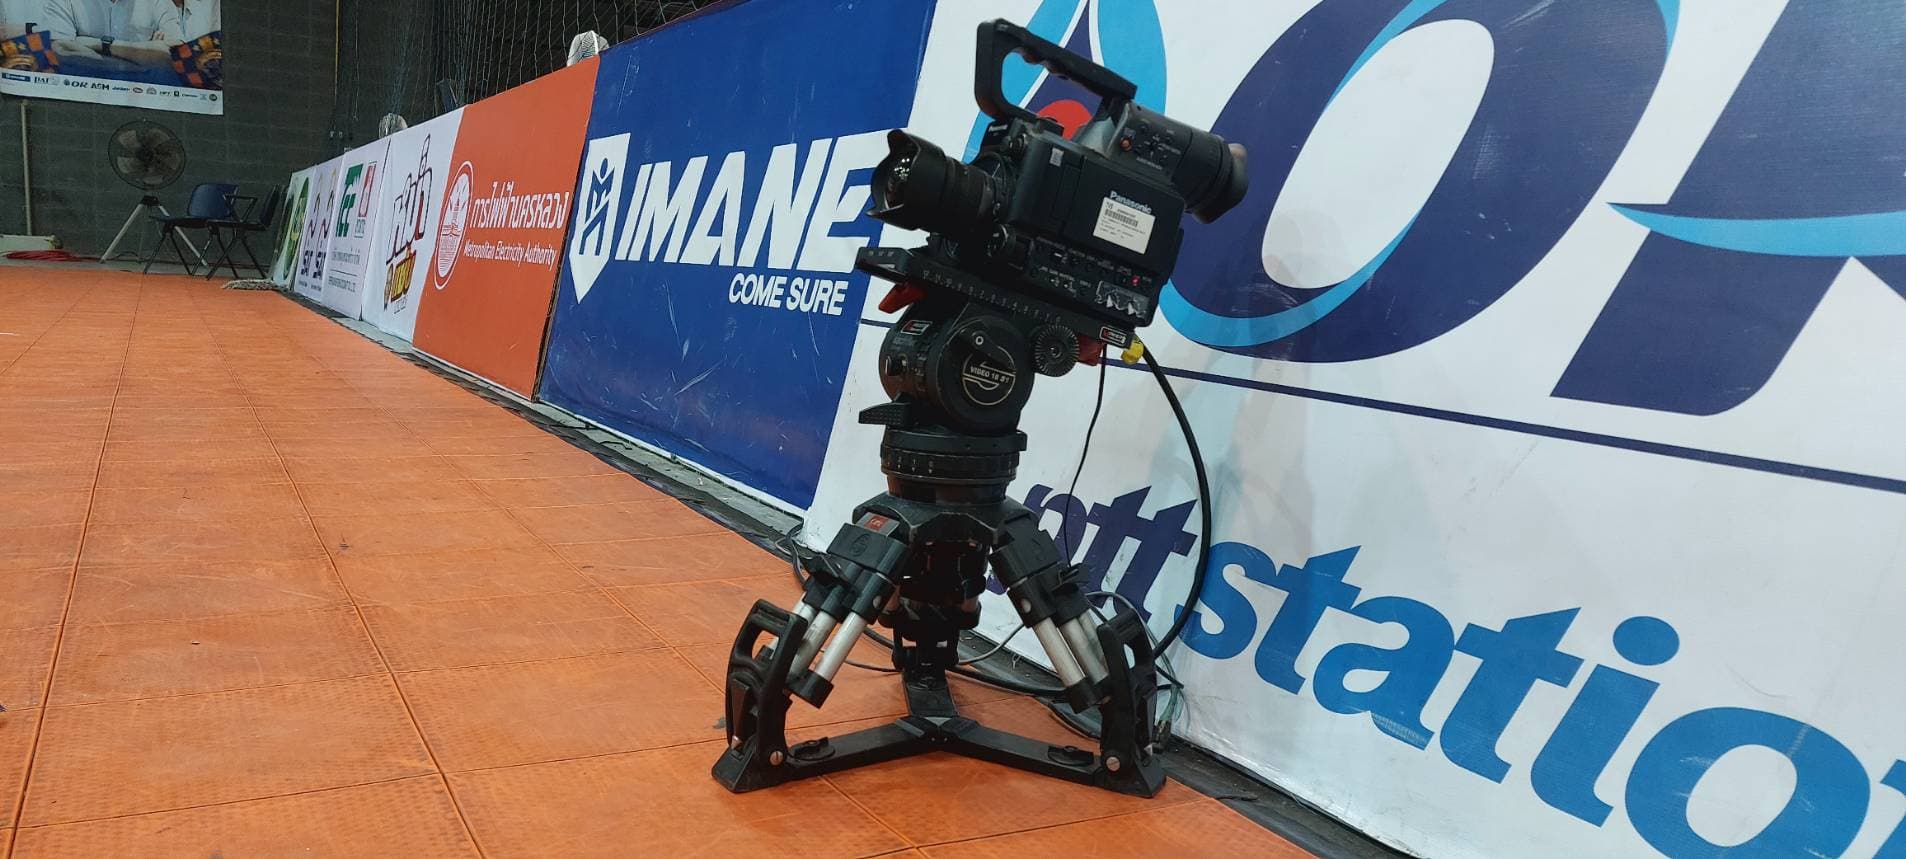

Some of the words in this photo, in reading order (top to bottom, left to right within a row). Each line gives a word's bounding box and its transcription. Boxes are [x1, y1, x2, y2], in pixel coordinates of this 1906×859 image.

[469, 181, 570, 229] การไฟฟ้านครหลวง
[614, 129, 893, 273] IMANE
[1110, 190, 1152, 213] Panasonic
[464, 240, 495, 262] Metropolitan
[495, 241, 525, 268] Electricity
[525, 241, 557, 271] Authority
[729, 273, 788, 308] COME
[788, 277, 849, 315] SURE
[970, 366, 990, 378] VIDEO
[985, 484, 1198, 624] ptt
